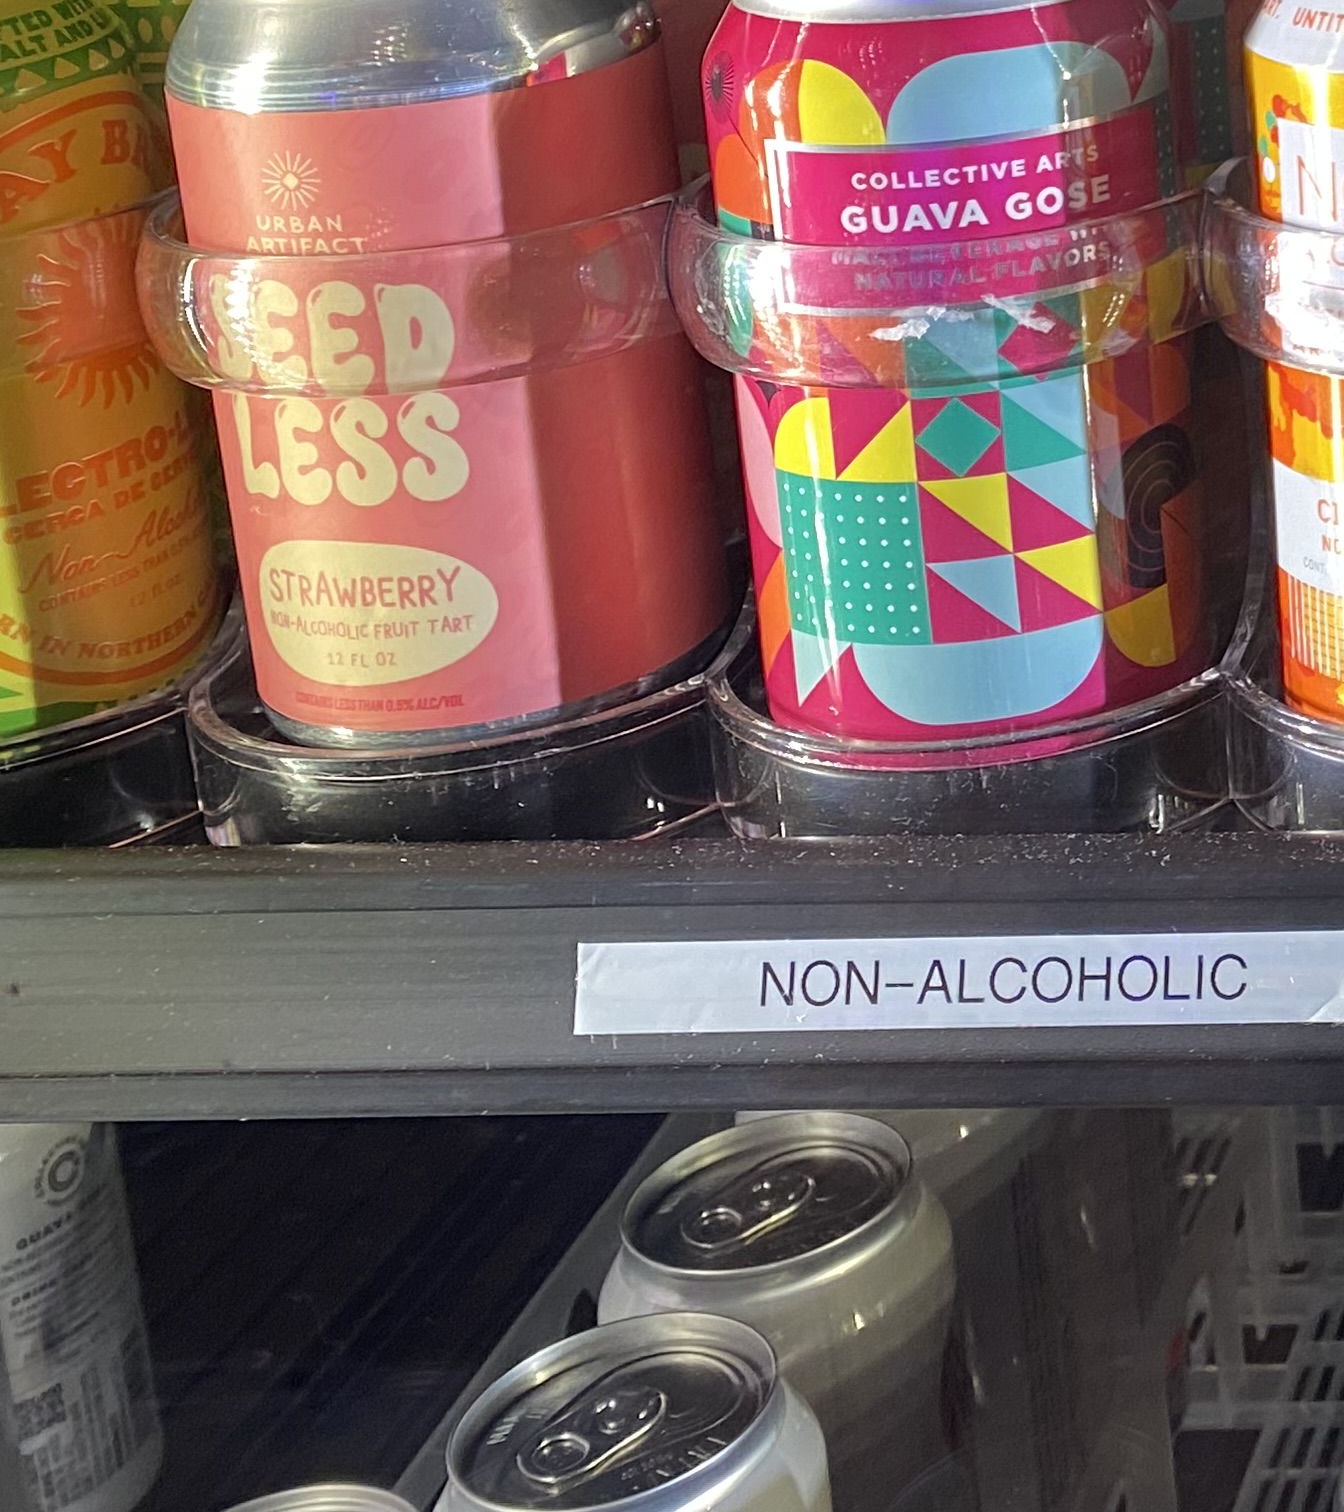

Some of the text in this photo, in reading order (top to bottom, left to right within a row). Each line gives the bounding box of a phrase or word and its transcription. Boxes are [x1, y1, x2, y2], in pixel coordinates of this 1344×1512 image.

[850, 144, 1100, 191] COLLECTIVE ARTS
[255, 214, 344, 234] URBAN
[839, 174, 1112, 235] GUAVA GOSE
[245, 235, 368, 255] ARTIFACT
[992, 240, 1112, 279] FLAVORS
[207, 272, 456, 395] SEED
[231, 392, 470, 507] LESS
[268, 565, 462, 610] STRAWBERRY
[270, 609, 475, 641] NON-ALCOHOLIC FRUIT TART
[327, 651, 398, 668] 12 FL OZ
[759, 952, 1249, 1008] NON-ALCOHOLIC
